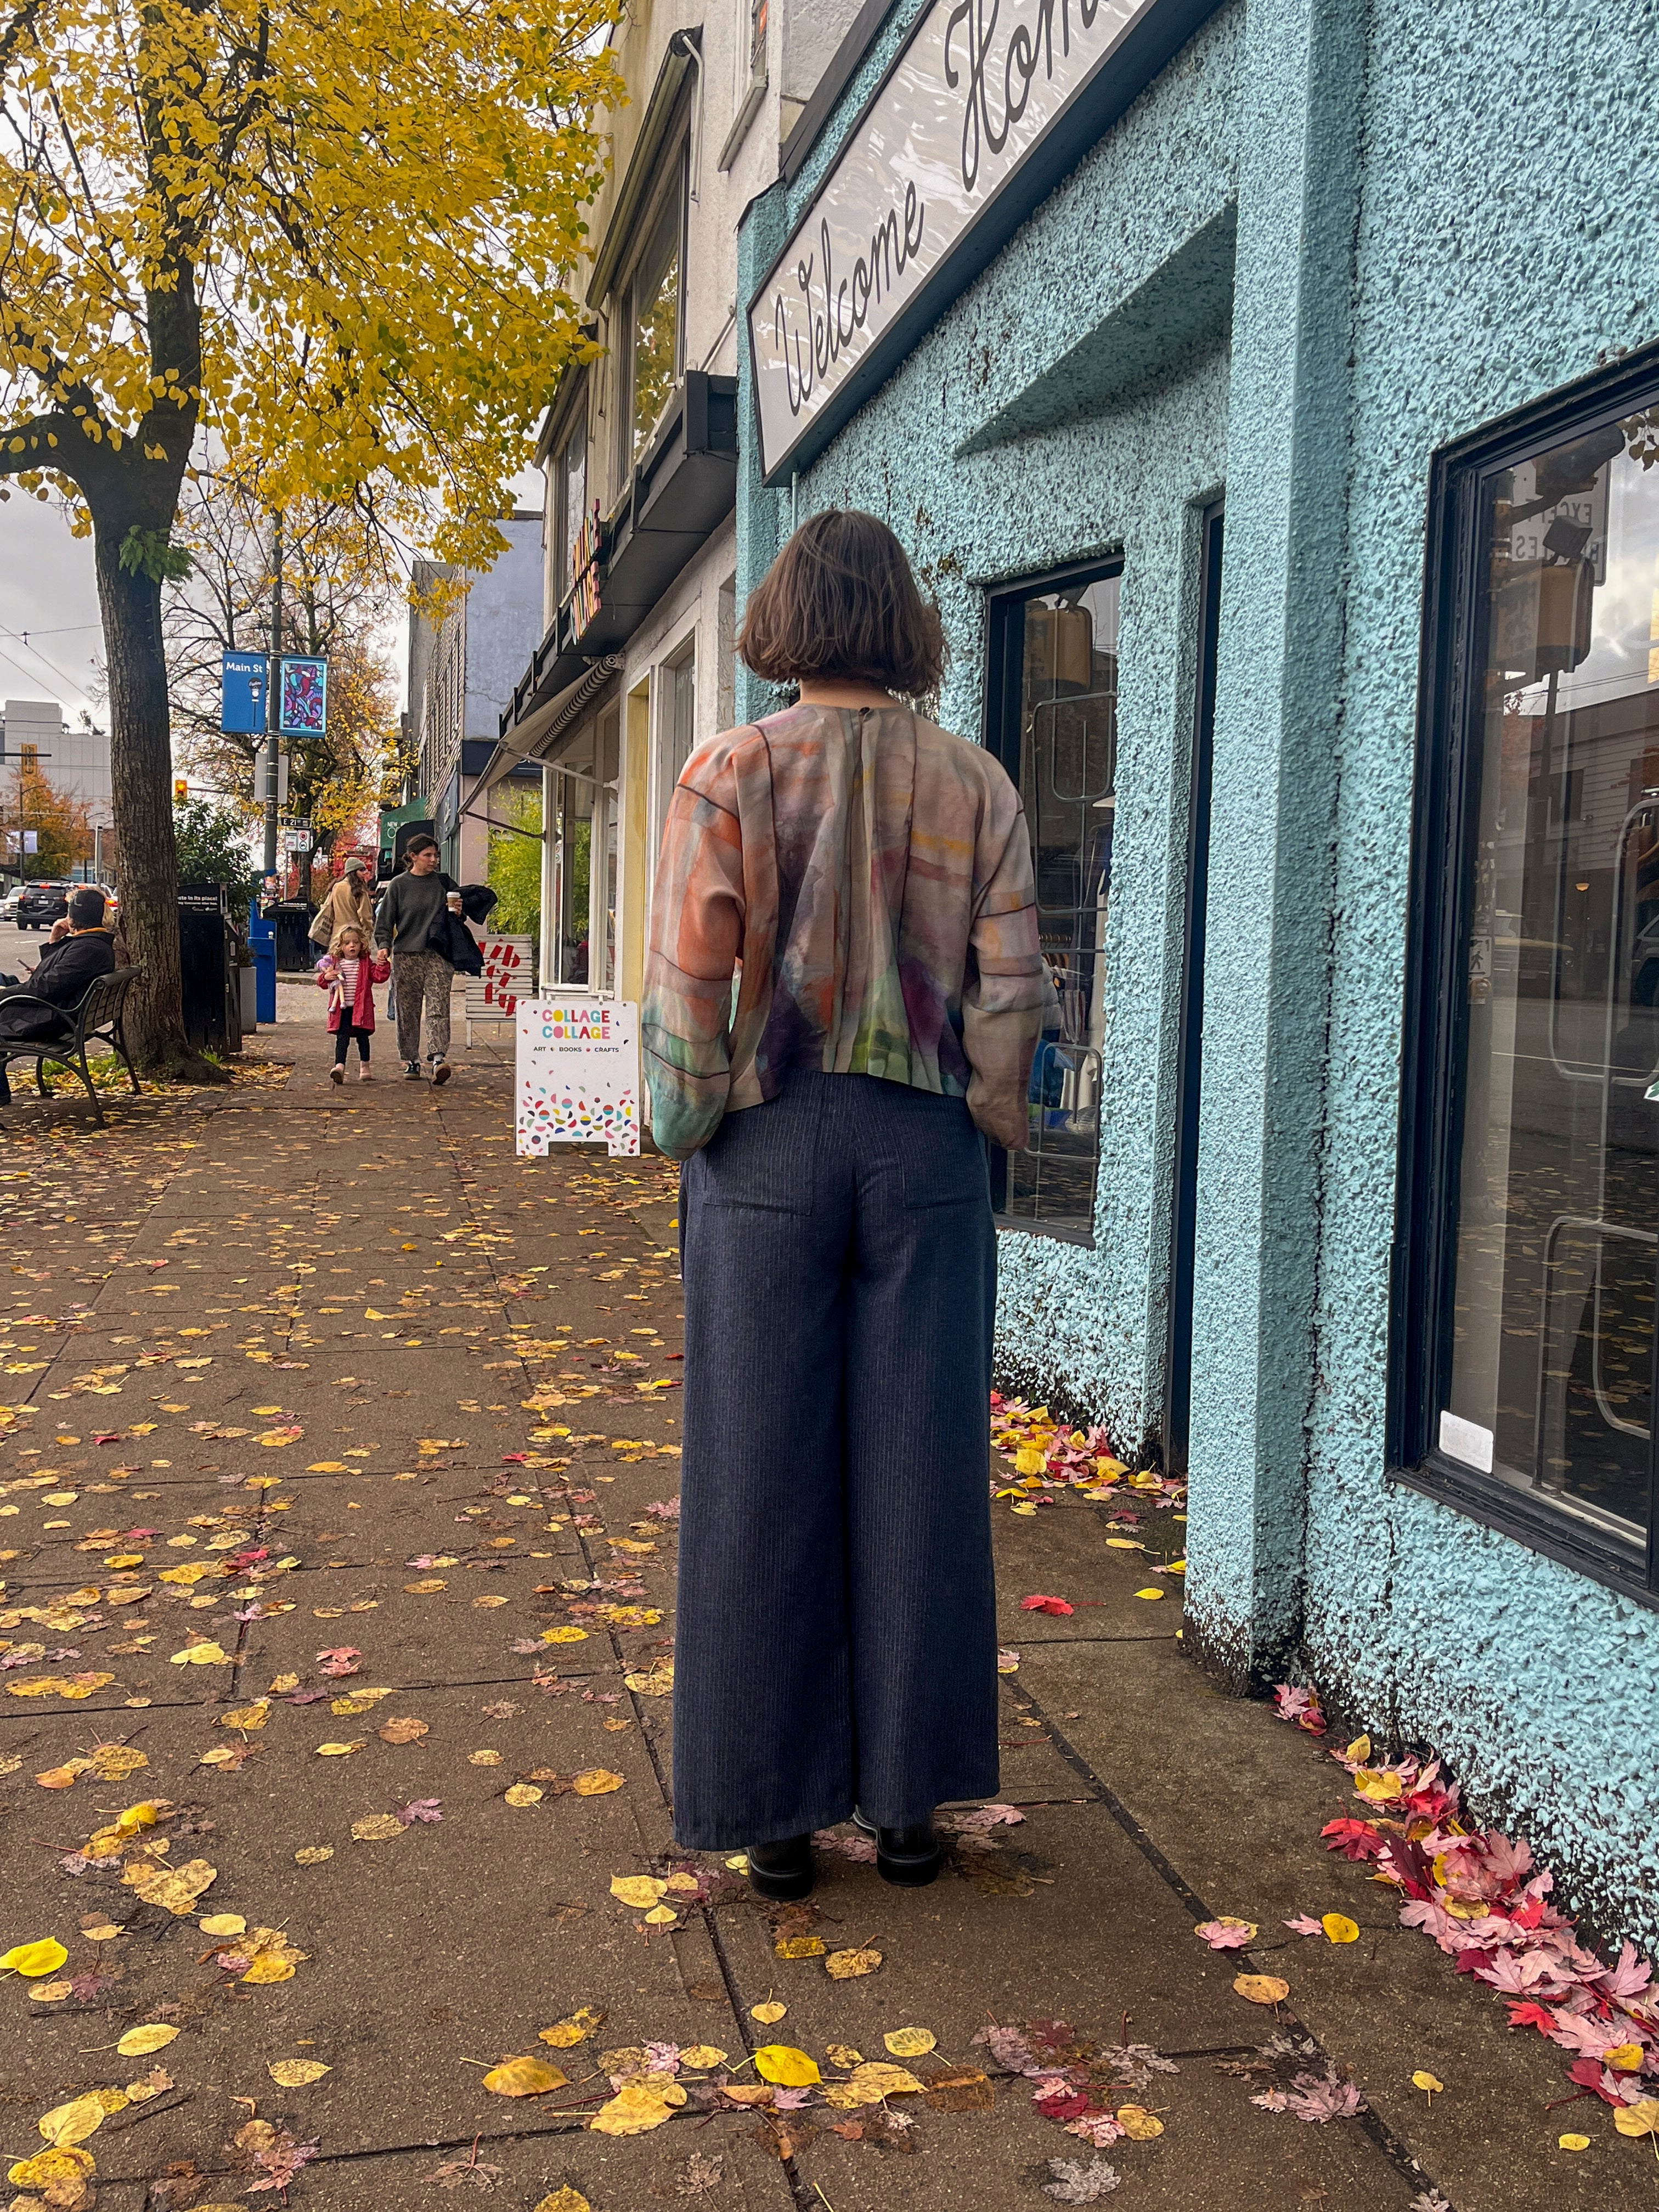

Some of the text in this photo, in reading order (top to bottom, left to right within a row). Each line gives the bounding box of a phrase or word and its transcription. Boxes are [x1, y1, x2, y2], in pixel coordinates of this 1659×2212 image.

[775, 0, 1099, 416] Welcome Hom
[226, 662, 263, 673] Main St
[542, 1009, 610, 1023] COLLAGE
[542, 1025, 610, 1039] COLLAGE
